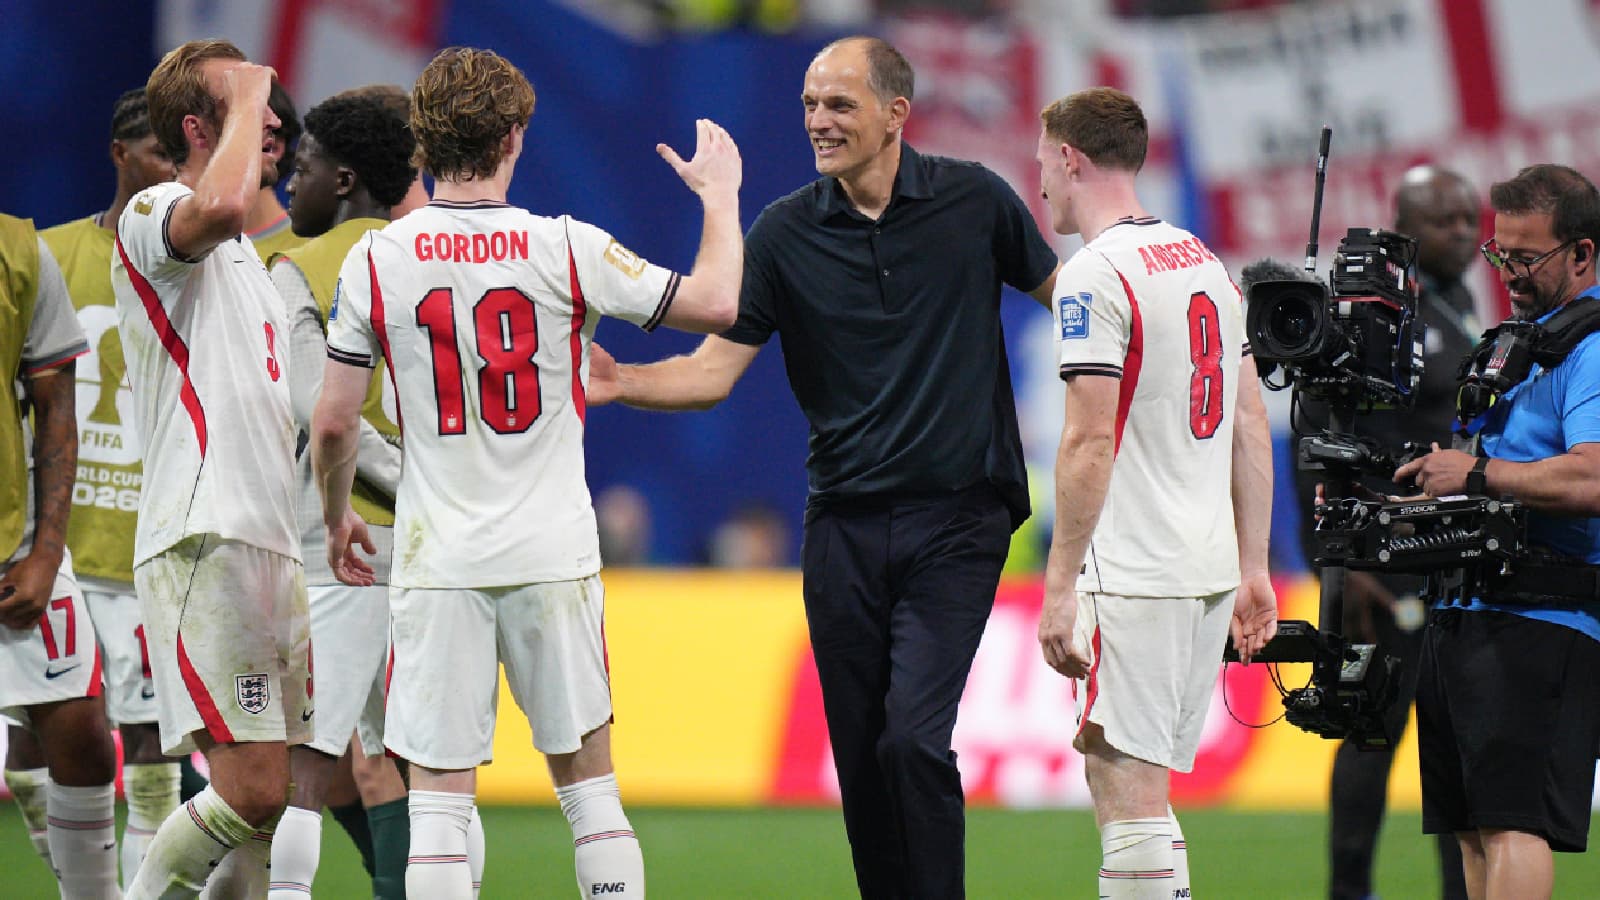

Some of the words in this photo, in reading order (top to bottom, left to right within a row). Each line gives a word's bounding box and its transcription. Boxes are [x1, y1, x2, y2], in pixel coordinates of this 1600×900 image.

[415, 230, 529, 264] GORDON
[1138, 236, 1218, 275] ANDERSO
[415, 287, 542, 435] 18
[1187, 291, 1223, 440] 8
[81, 430, 123, 449] FIFA
[76, 466, 110, 483] RLD
[72, 482, 140, 512] 026
[39, 596, 76, 661] 17
[134, 623, 153, 678] 1
[591, 882, 625, 895] ENG
